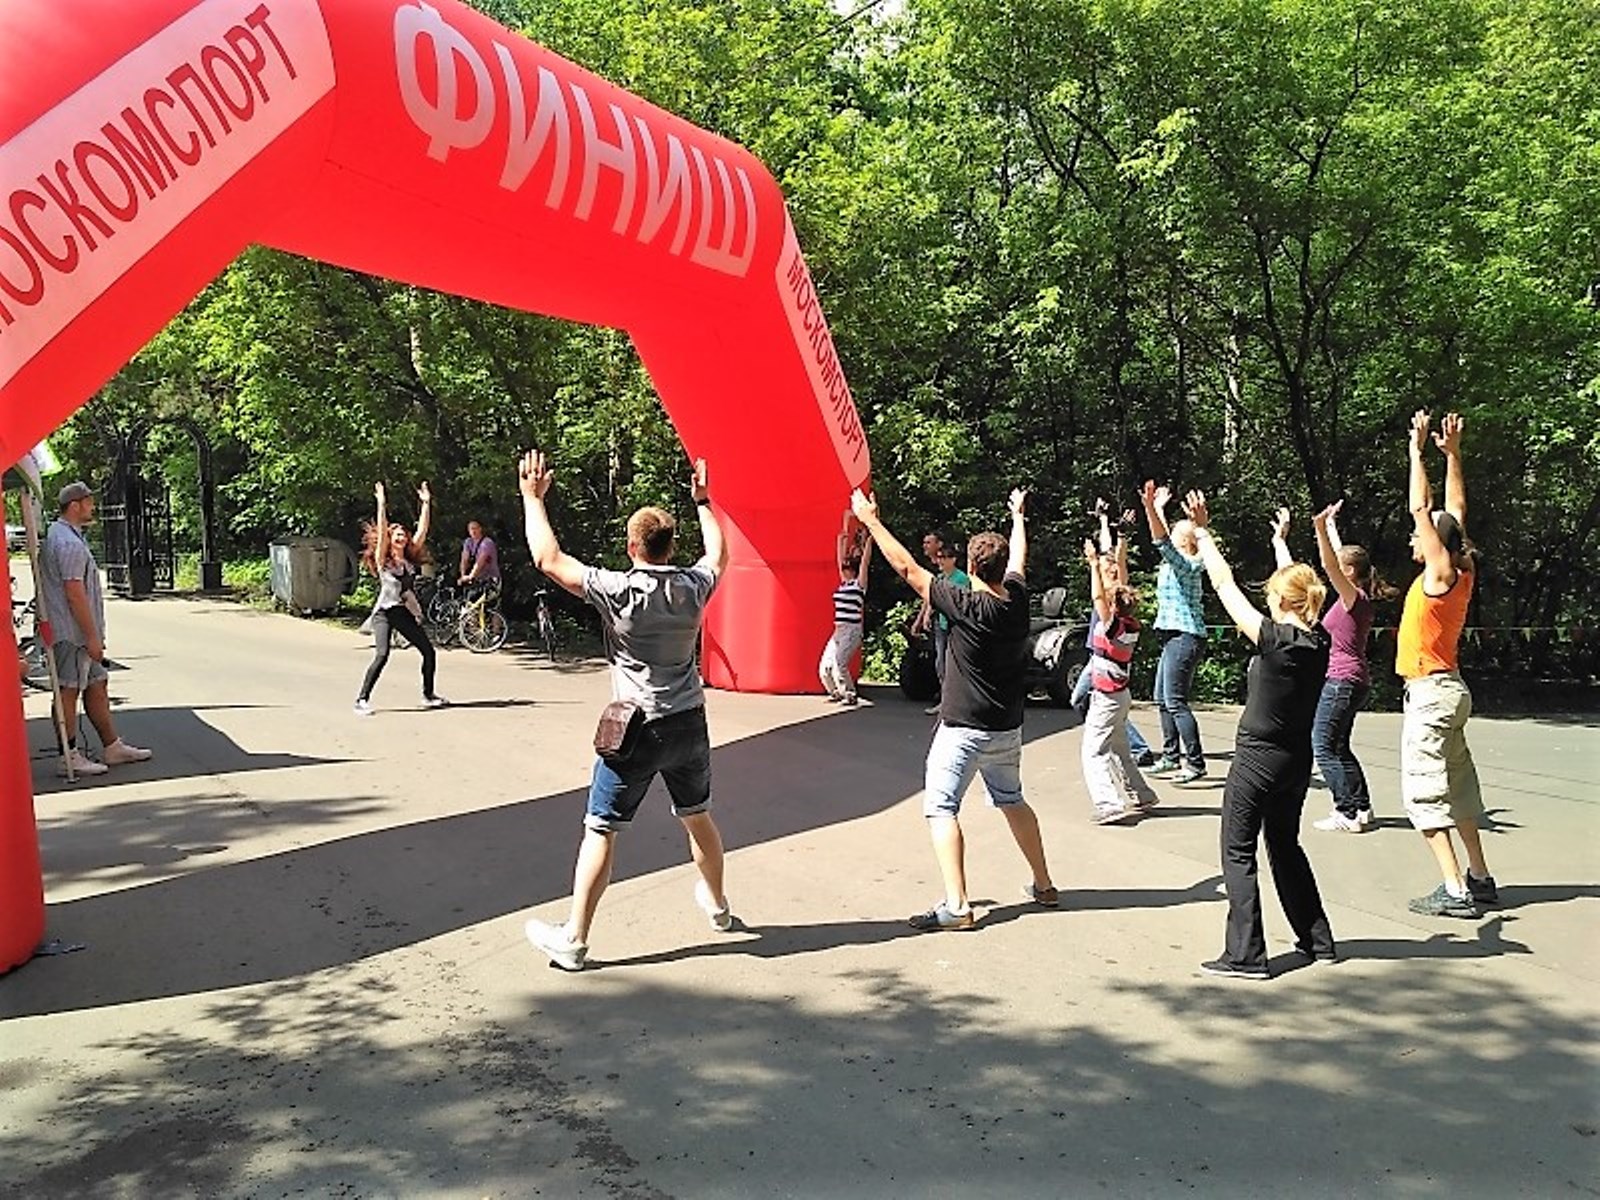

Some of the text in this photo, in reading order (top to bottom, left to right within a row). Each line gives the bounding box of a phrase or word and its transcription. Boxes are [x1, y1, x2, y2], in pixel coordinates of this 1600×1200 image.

[0, 3, 297, 334] ОСКОМСПОРТ
[394, 0, 757, 278] ФИНИШ
[787, 253, 865, 463] МОСКОМСПОРТ
